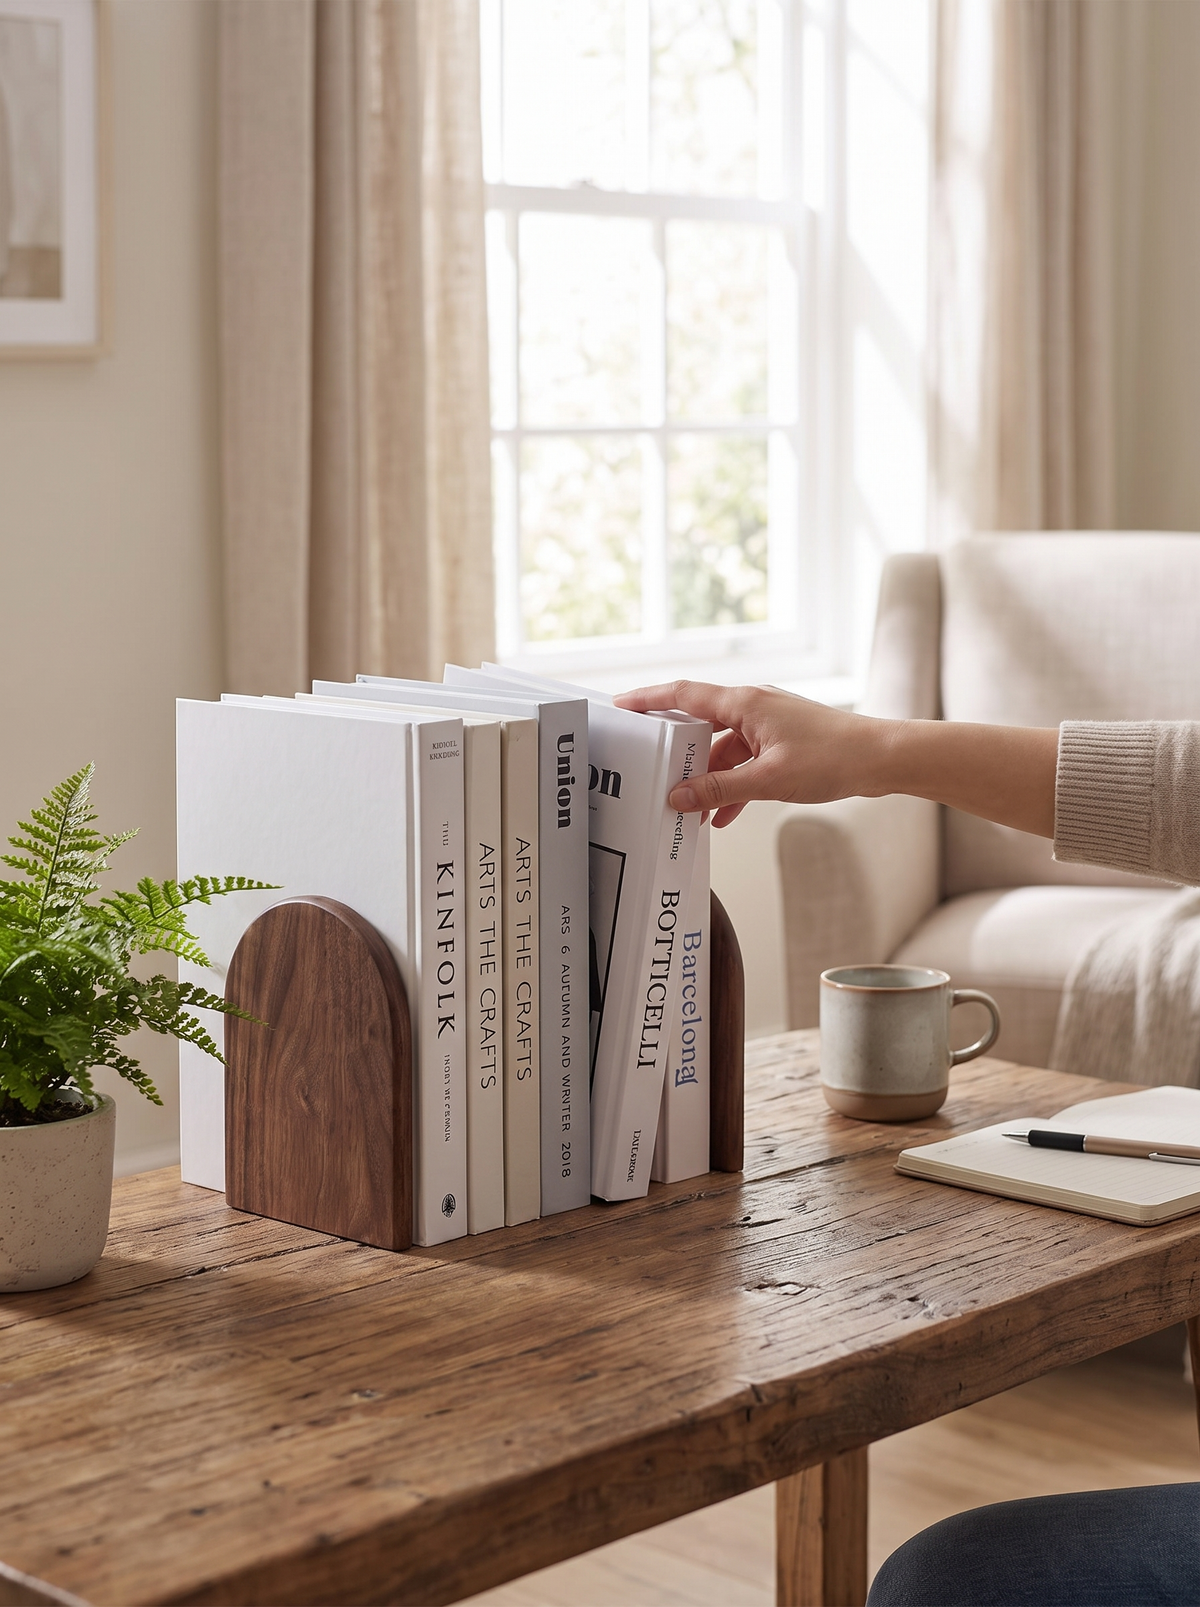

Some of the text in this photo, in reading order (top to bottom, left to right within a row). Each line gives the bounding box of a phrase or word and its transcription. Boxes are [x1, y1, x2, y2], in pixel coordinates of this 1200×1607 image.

[557, 731, 575, 829] Union
[436, 860, 455, 1039] KINFOLK
[479, 842, 497, 1089] ARTS THE CRAFTS
[515, 837, 532, 1081] ARTS THE CRAFTS
[561, 905, 571, 935] ARS
[561, 945, 571, 955] 6
[637, 889, 681, 1069] BOTTICELLI
[561, 1035, 571, 1068] AND
[561, 1142, 572, 1178] 2018
